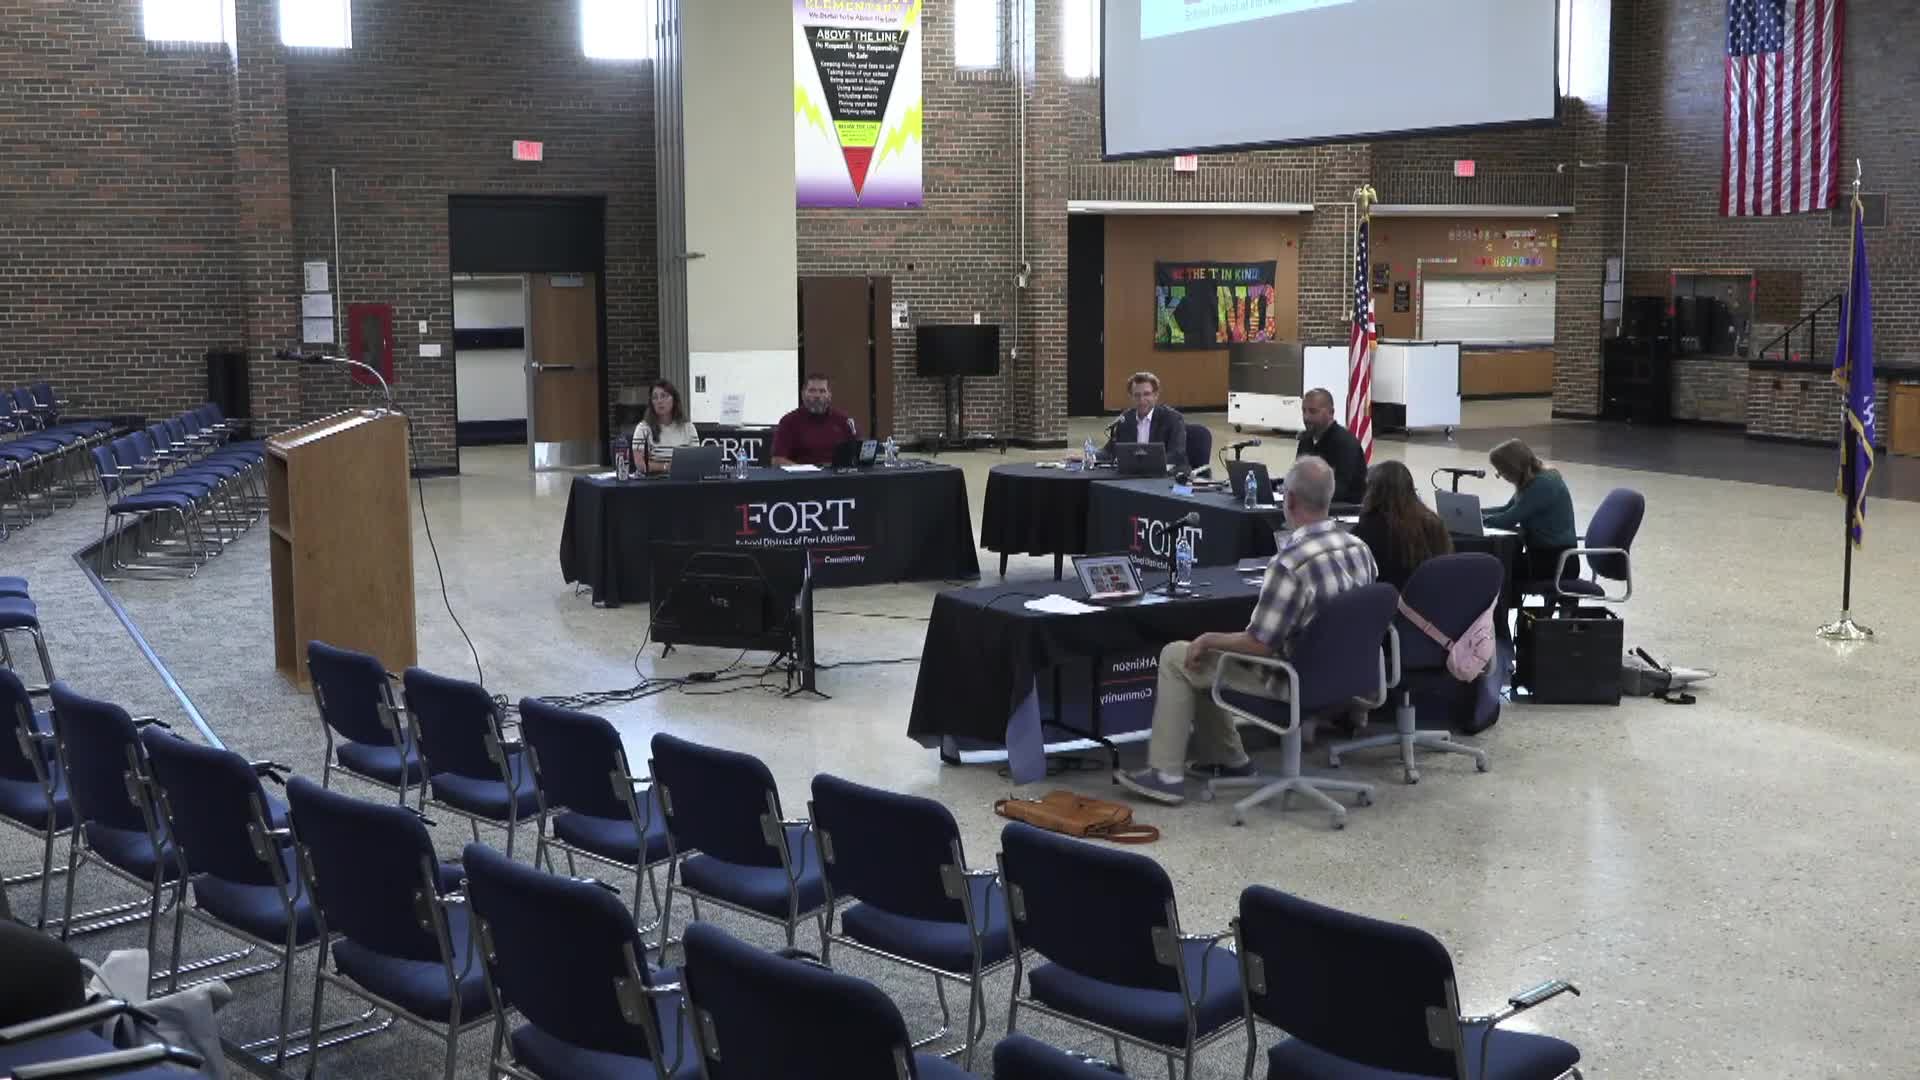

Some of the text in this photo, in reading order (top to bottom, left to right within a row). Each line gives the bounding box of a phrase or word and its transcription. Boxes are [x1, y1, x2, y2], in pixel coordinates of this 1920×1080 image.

[817, 29, 897, 41] ABOVE THE LINE
[820, 61, 840, 69] Keeping
[827, 69, 844, 77] Taking
[1186, 267, 1206, 280] THE
[1221, 267, 1233, 280] IN
[1234, 267, 1260, 280] KIND
[701, 438, 763, 462] RT
[735, 498, 855, 536] FORT
[763, 537, 793, 548] District
[794, 536, 802, 545] of
[803, 535, 819, 545] Fort
[821, 534, 856, 544] Atkinson
[824, 554, 865, 565] Community
